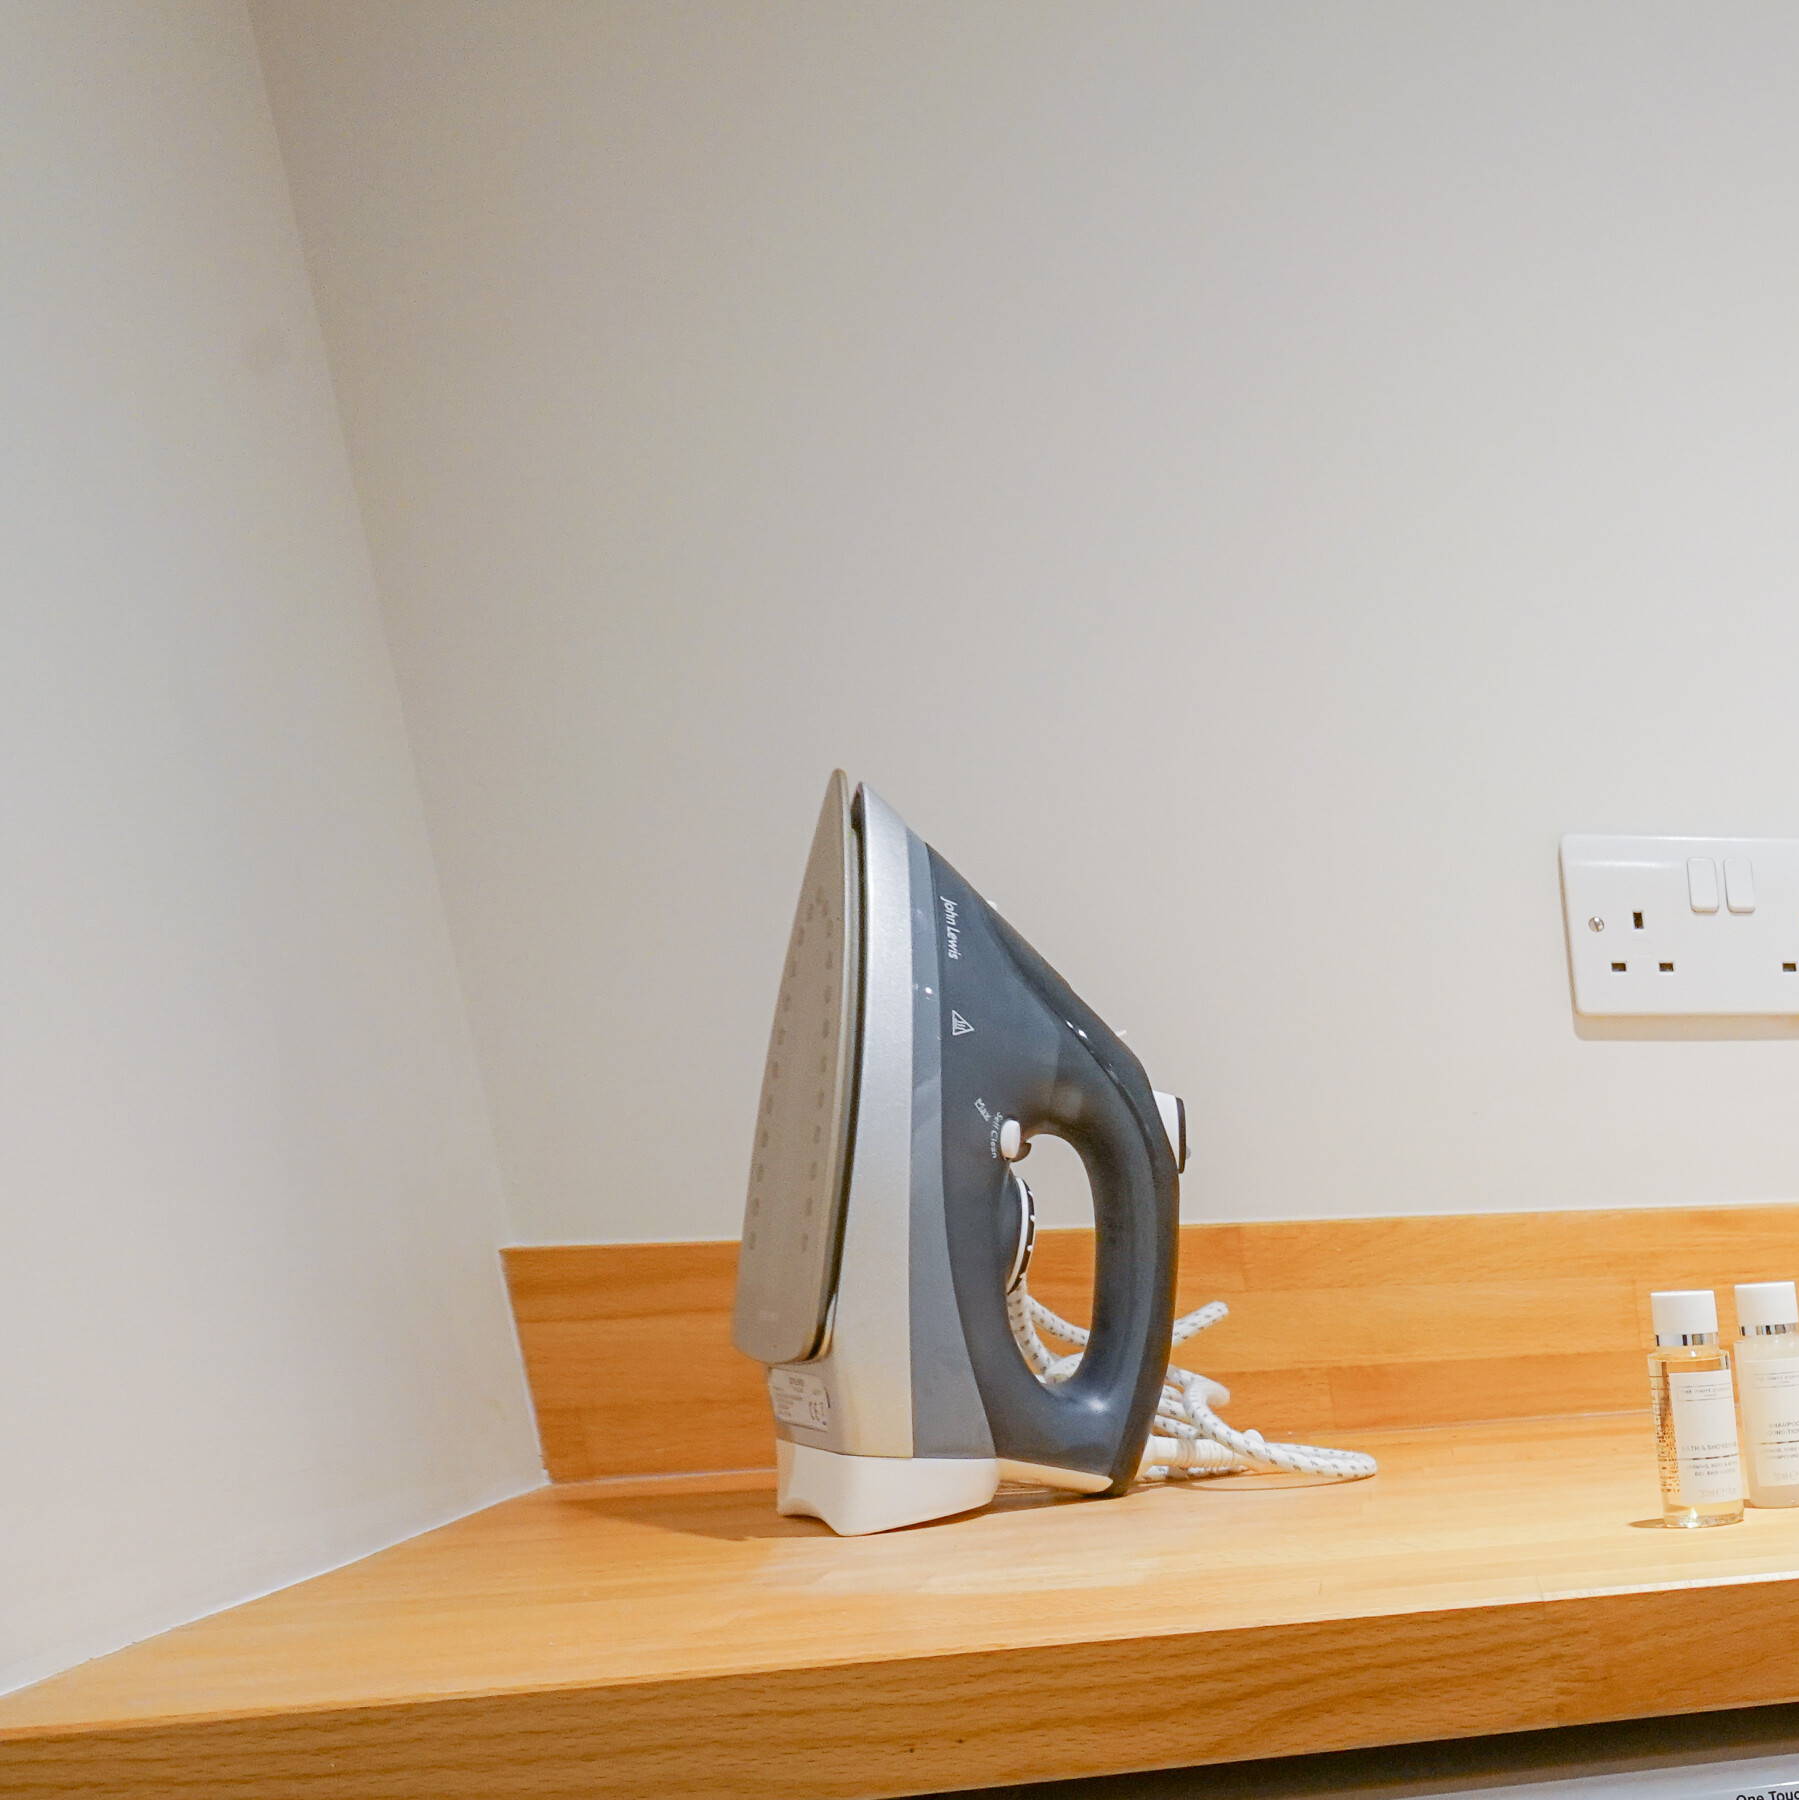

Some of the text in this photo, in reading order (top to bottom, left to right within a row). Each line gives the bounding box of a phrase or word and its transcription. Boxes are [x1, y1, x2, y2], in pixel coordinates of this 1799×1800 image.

[940, 896, 962, 960] John Lewis
[990, 1130, 999, 1159] Clean
